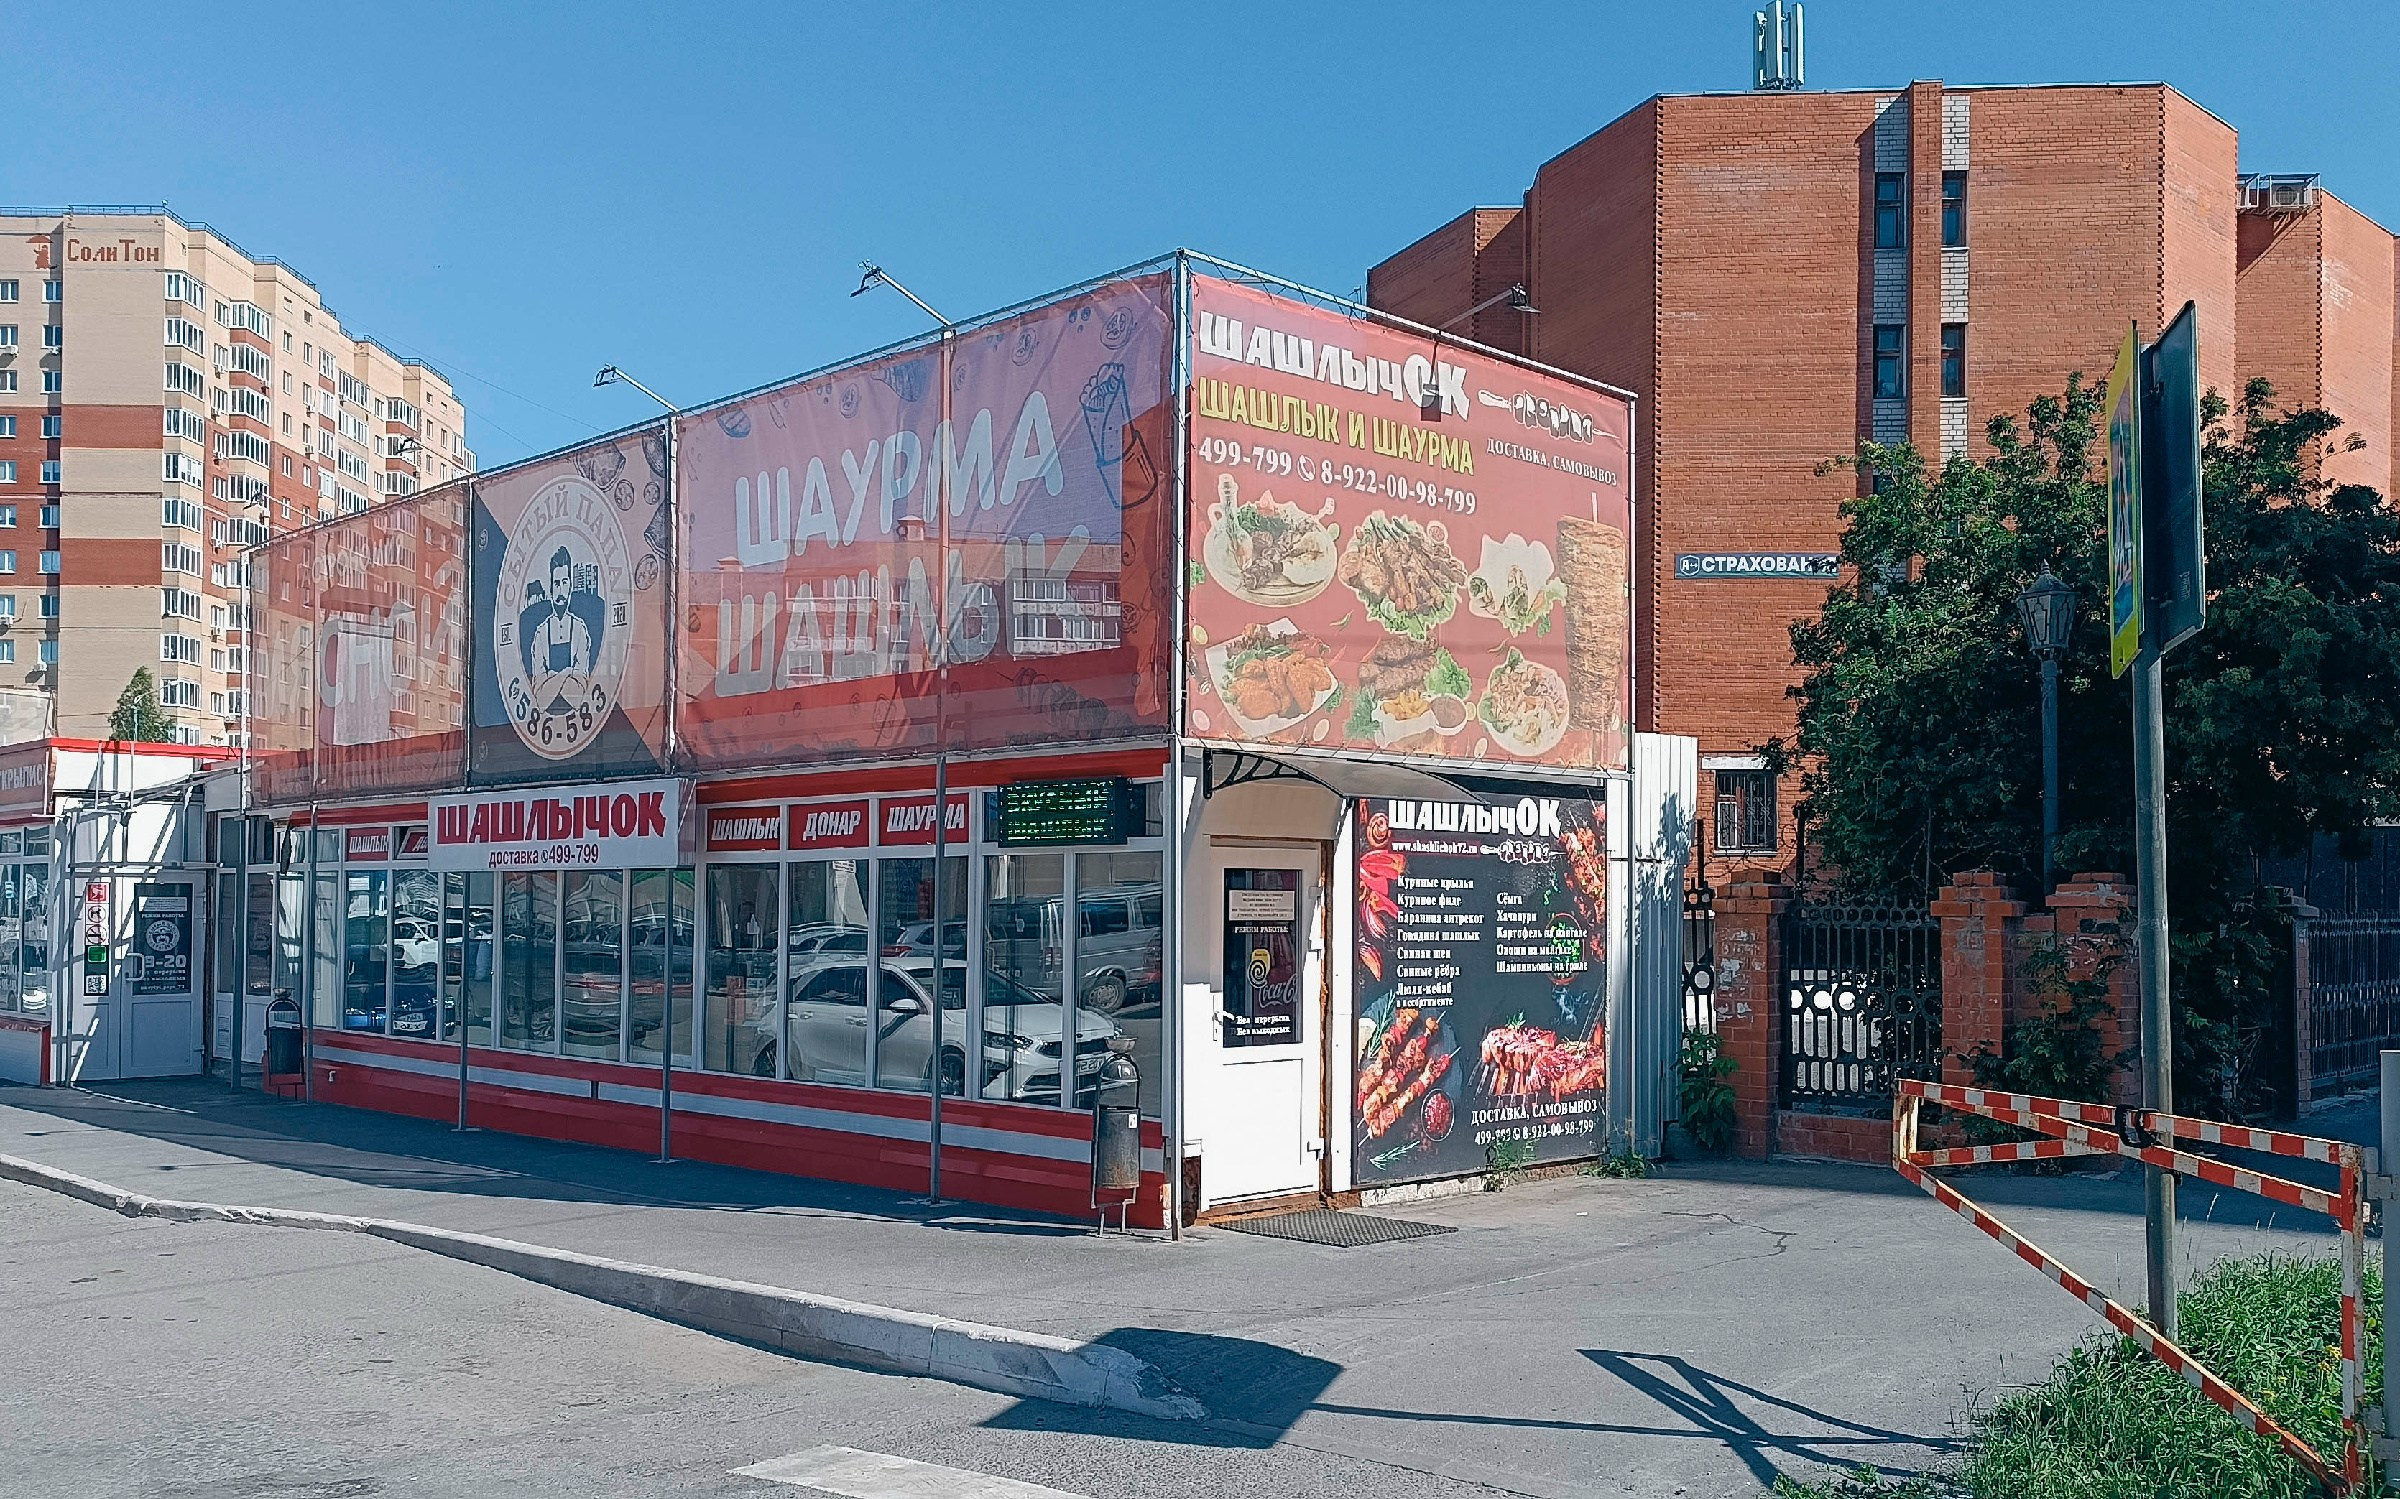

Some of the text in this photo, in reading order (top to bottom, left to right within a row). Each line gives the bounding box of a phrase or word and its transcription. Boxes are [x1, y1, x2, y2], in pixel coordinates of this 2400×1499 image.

[1199, 375, 1475, 477] ШАШЛЫК И ШАУРМА
[1486, 437, 1618, 486] ДОСТАВКА, САМОВЫВОЗ
[735, 390, 1065, 569] ШАУРМА
[1198, 436, 1477, 516] 499-799 8-922-00-98-799
[502, 484, 623, 607] СЫТЫЙ ПАПА
[714, 523, 1090, 698] ШАШЛЫК
[516, 683, 607, 745] 586-583
[437, 791, 667, 844] ШАШЛЫЧОК
[802, 810, 861, 841] ДОНАР
[488, 843, 599, 868] доставка 499-799
[1397, 875, 1474, 891] Куриные крылья
[1397, 892, 1462, 909] Куриное филе
[1496, 892, 1523, 905] Сёмга
[1397, 911, 1485, 926] Баранина антрекот
[1496, 909, 1537, 924] Хачапури
[1397, 928, 1481, 942] Говядина шашлык
[1496, 926, 1543, 940] Картофель
[1544, 929, 1554, 938] на
[1396, 946, 1451, 959] Свиная шея
[1496, 944, 1527, 956] Овощи
[1528, 946, 1538, 955] на
[1396, 963, 1460, 979] Свиные рёбра
[1496, 961, 1588, 973] Шампиньоны на гриле
[1396, 981, 1453, 996] Люля-кебаб
[1471, 1099, 1598, 1126] ДОСТАВКА, САМОВЫВОЗ
